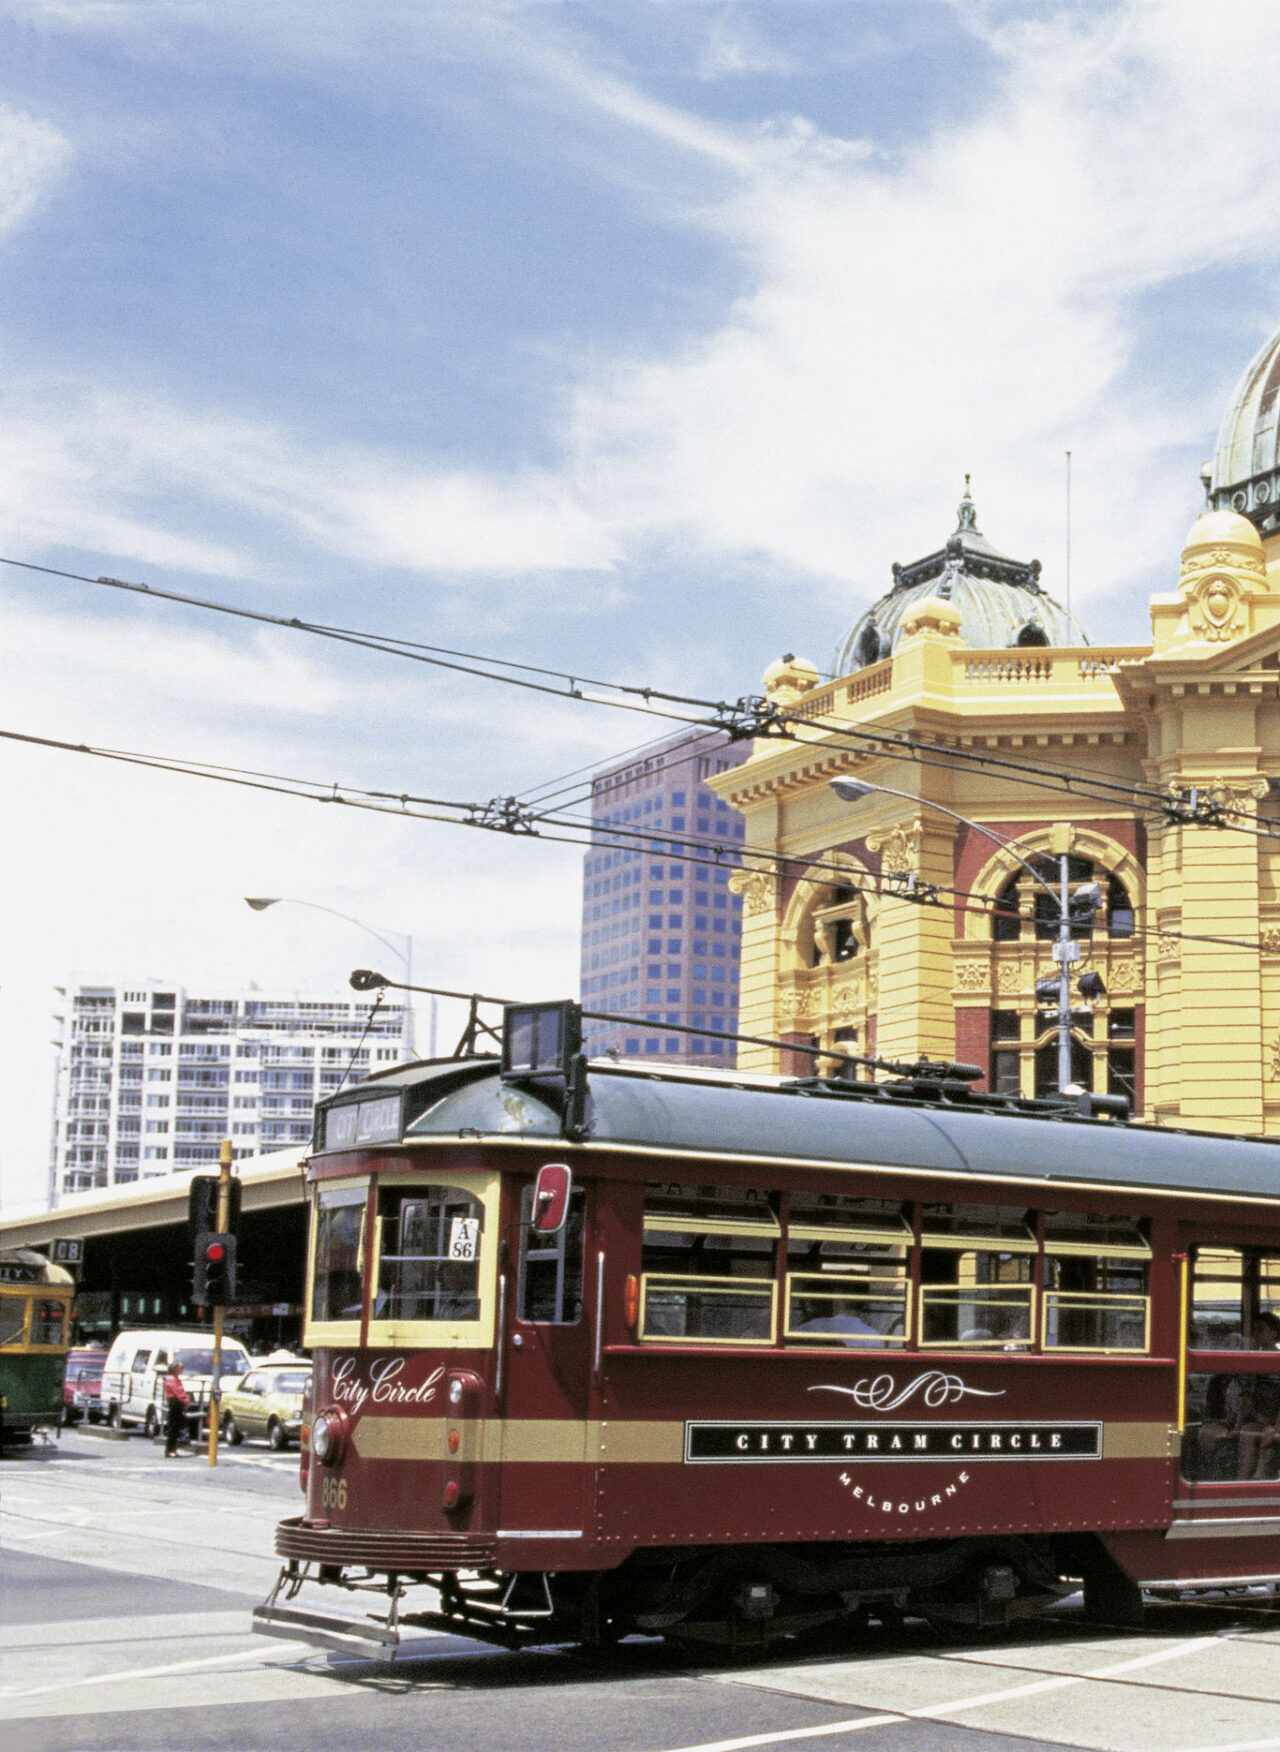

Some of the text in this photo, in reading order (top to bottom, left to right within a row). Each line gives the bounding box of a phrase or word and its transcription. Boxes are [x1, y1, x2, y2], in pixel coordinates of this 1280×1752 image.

[457, 1223, 471, 1240] A
[452, 1241, 473, 1258] 86
[332, 1357, 445, 1415] City Circle
[736, 1434, 1061, 1449] CITY TRAM CIRCLE
[322, 1476, 348, 1510] 866
[839, 1471, 969, 1513] MELBOURNE
